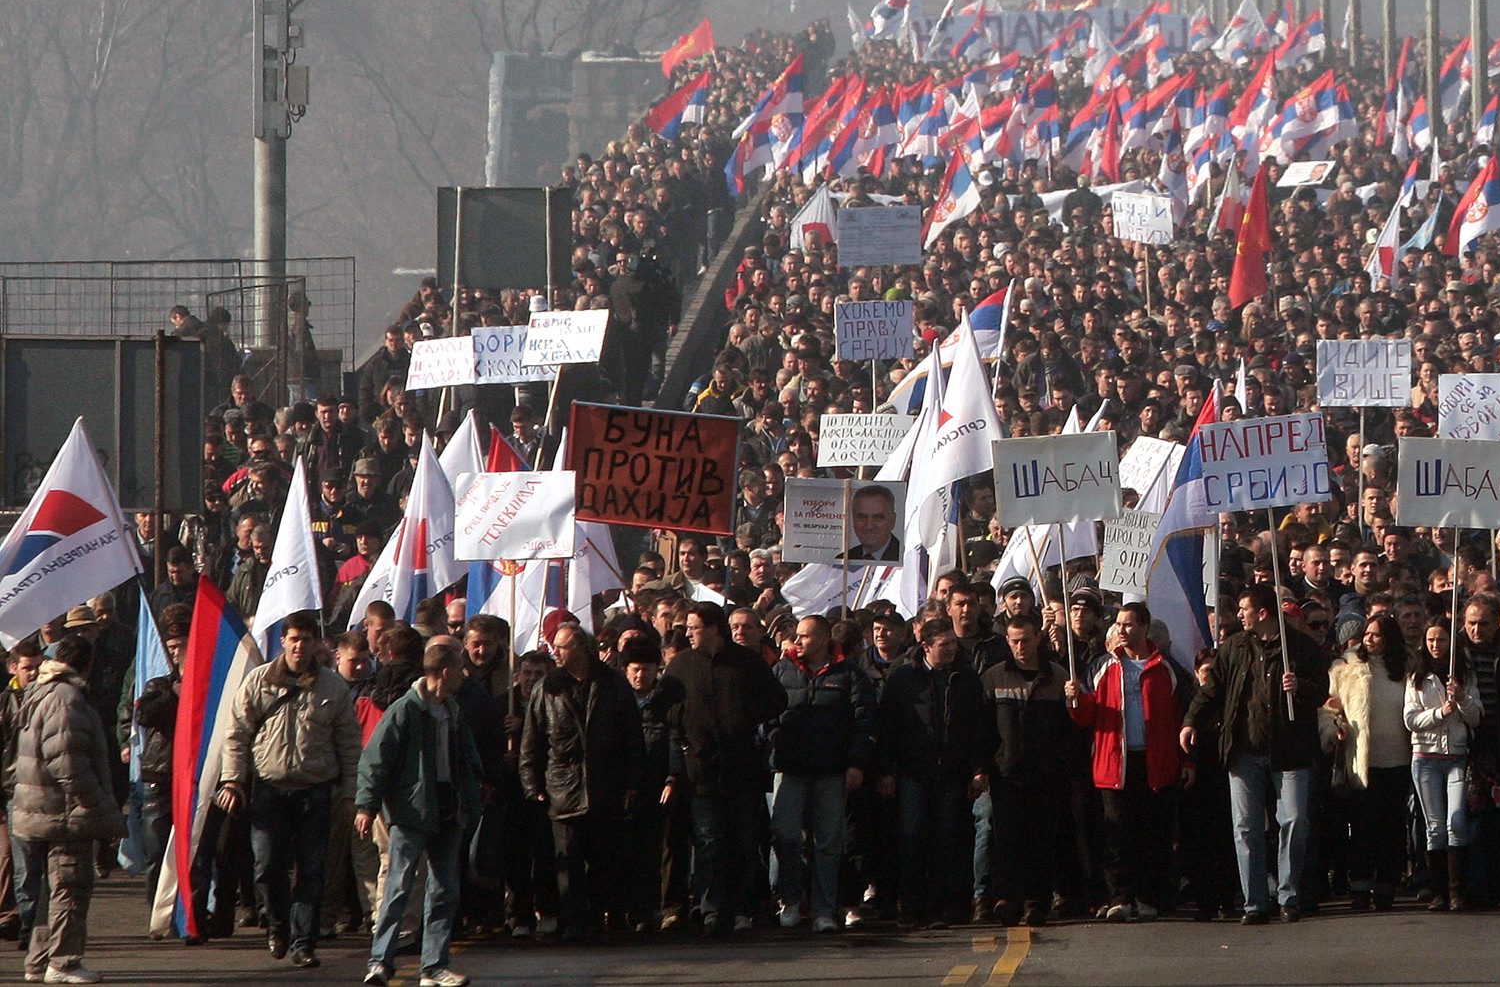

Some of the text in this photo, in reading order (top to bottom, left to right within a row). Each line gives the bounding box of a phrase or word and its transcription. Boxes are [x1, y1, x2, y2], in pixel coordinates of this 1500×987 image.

[839, 302, 906, 320] ХОЋЕМО
[844, 319, 899, 338] ПРАВУ
[839, 338, 909, 360] СРБИЈУ
[1324, 342, 1409, 369] ИДИТЕ
[1333, 373, 1404, 400] ВИШЕ
[604, 409, 703, 453] БУНА
[1200, 417, 1326, 464] НАПРЕД
[583, 448, 725, 495] ПРОТИВ
[827, 451, 877, 463] ДОСТА
[1012, 460, 1115, 499] ШАБАЦ
[1204, 462, 1331, 507] СРБИЈО
[578, 482, 712, 528] ДАХИЈА
